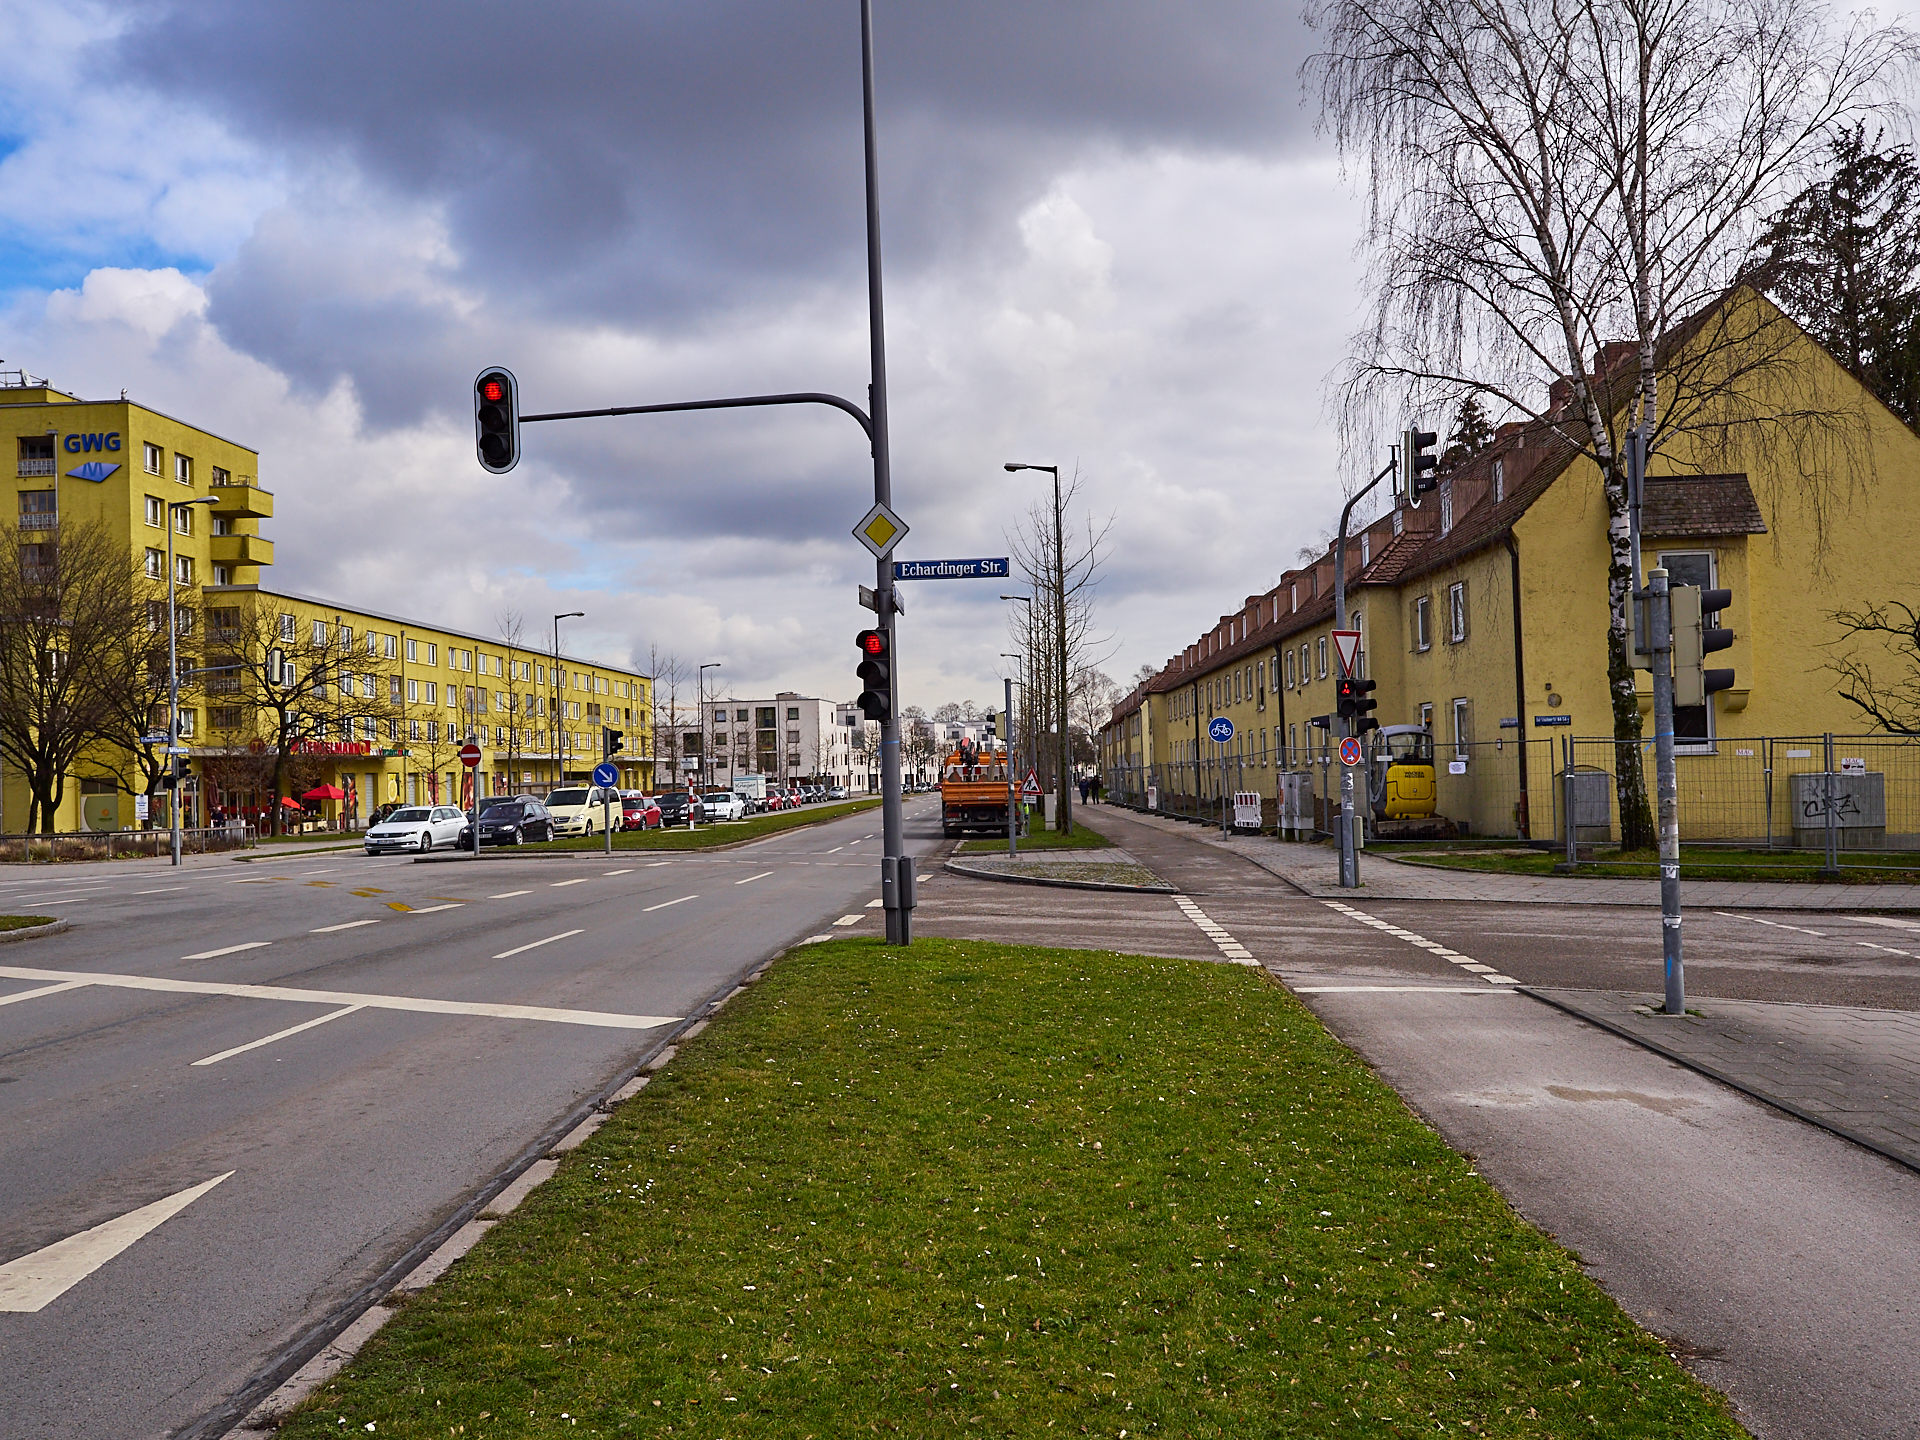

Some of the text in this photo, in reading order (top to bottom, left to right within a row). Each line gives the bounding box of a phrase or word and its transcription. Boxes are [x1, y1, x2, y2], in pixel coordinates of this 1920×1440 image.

[64, 432, 120, 452] GWG
[902, 560, 1002, 577] Echardinger Str.
